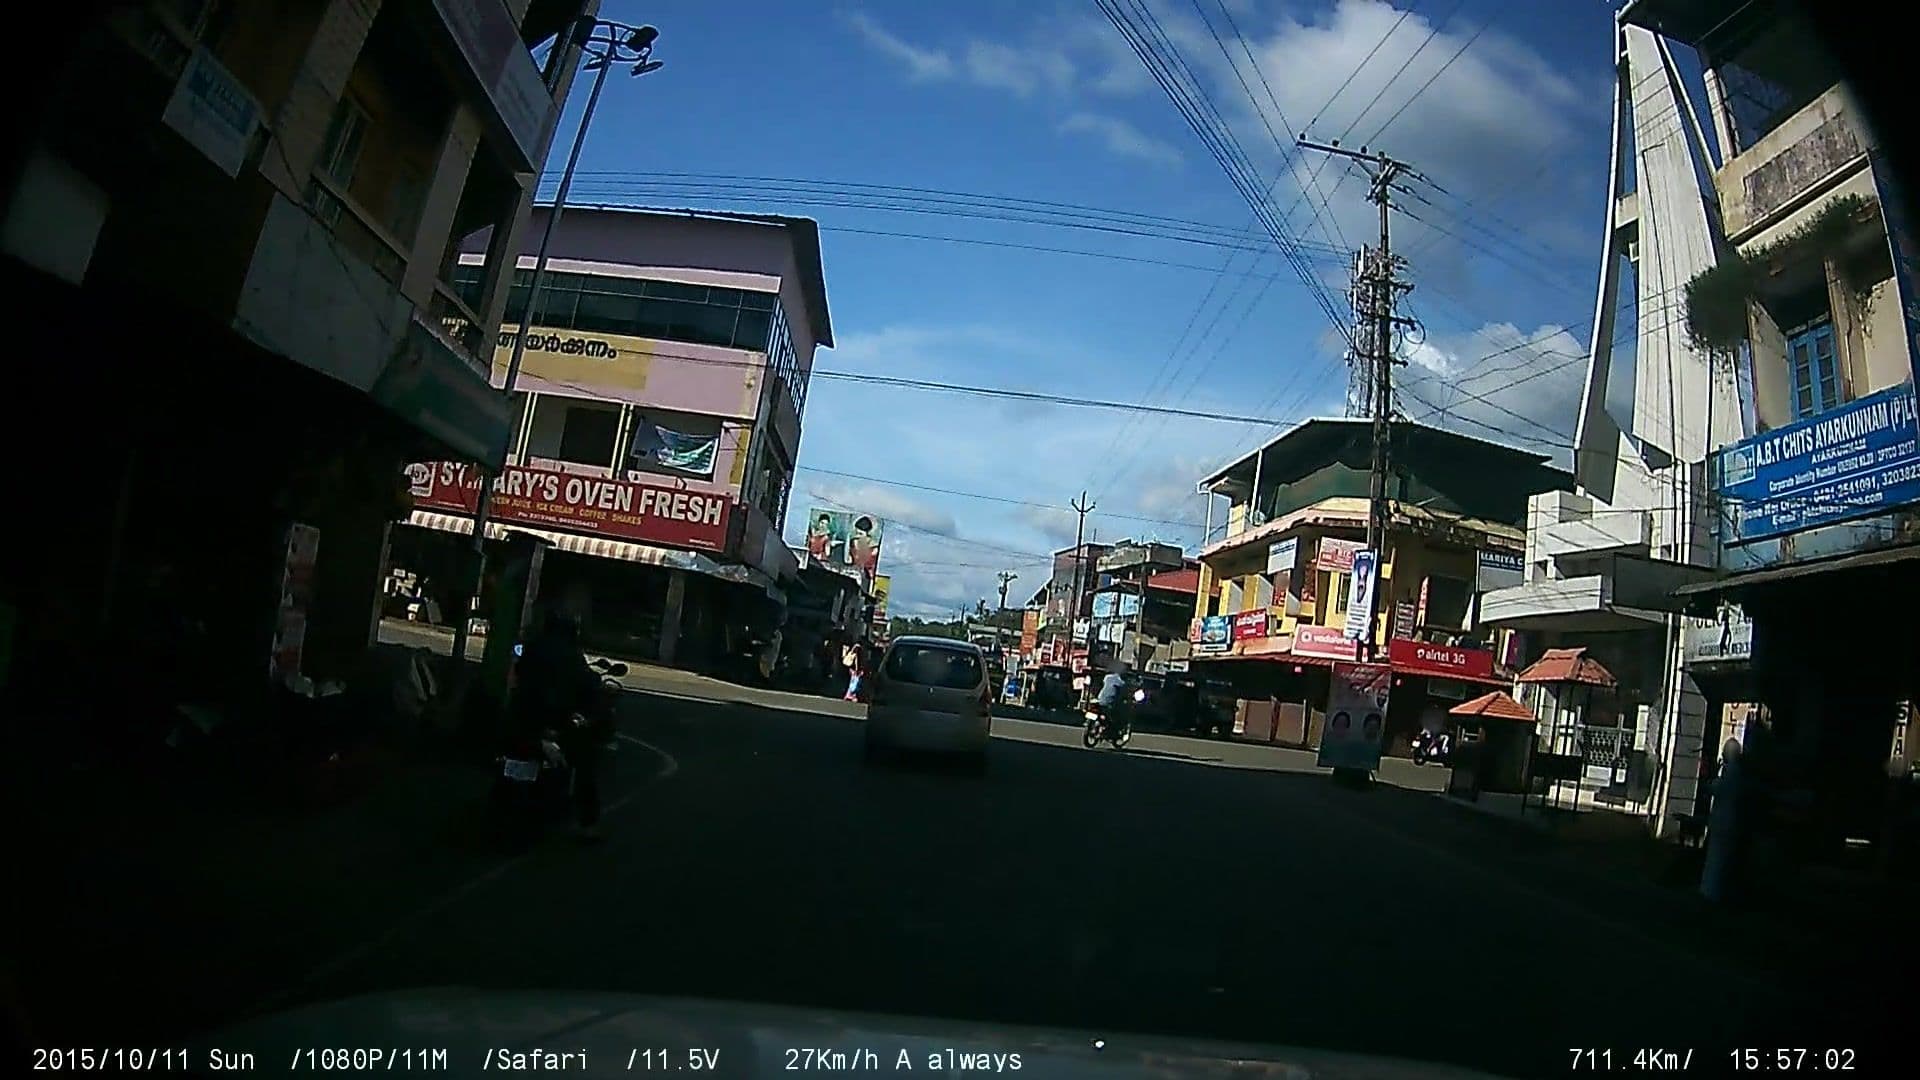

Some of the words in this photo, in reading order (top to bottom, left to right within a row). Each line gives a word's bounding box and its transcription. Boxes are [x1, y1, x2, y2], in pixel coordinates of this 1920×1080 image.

[1756, 440, 1781, 467] A.B.T
[1782, 427, 1813, 459] CHITS
[1815, 402, 1889, 449] AYARKUNNAM
[549, 504, 575, 515] CREAM
[579, 508, 607, 520] COFFEE
[612, 513, 643, 525] SHAKES
[565, 478, 634, 513] OVEN
[639, 488, 724, 526] FRESH
[1425, 649, 1449, 662] airtel
[1452, 653, 1466, 665] 3G
